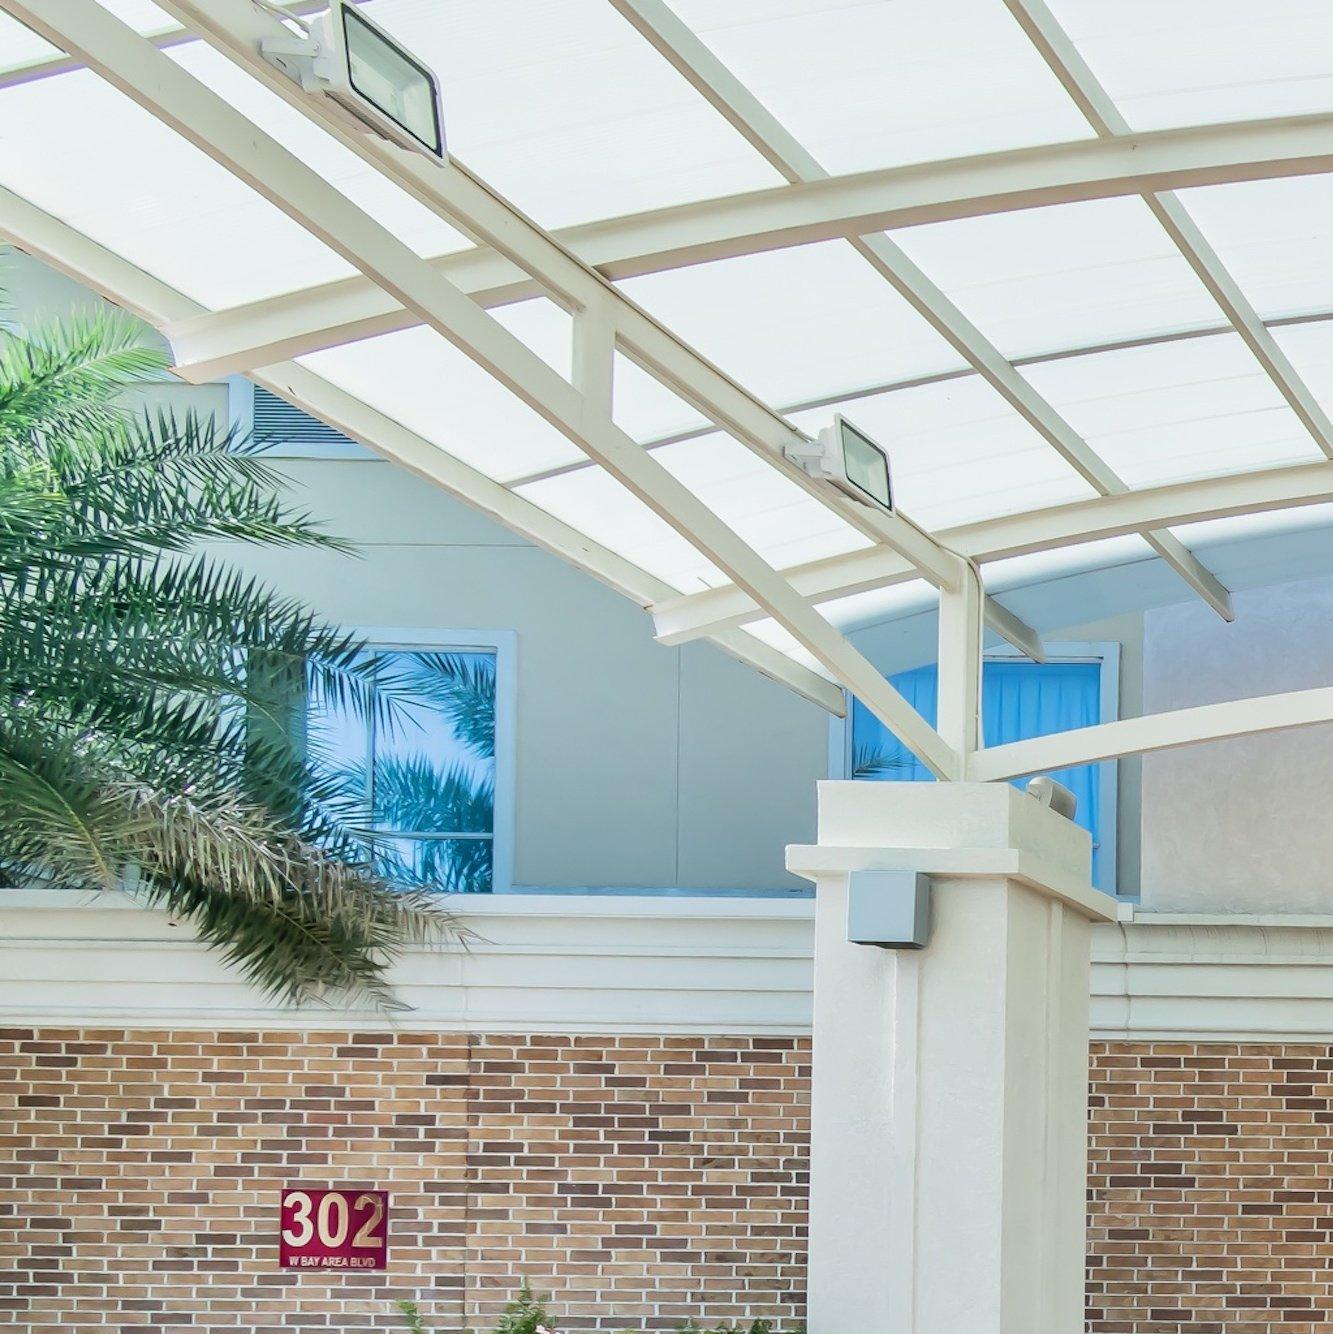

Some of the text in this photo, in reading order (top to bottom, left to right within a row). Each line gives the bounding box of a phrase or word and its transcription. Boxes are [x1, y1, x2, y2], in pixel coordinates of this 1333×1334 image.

[282, 1191, 383, 1248] 302
[289, 1256, 376, 1267] W BAY AREA BLVD
